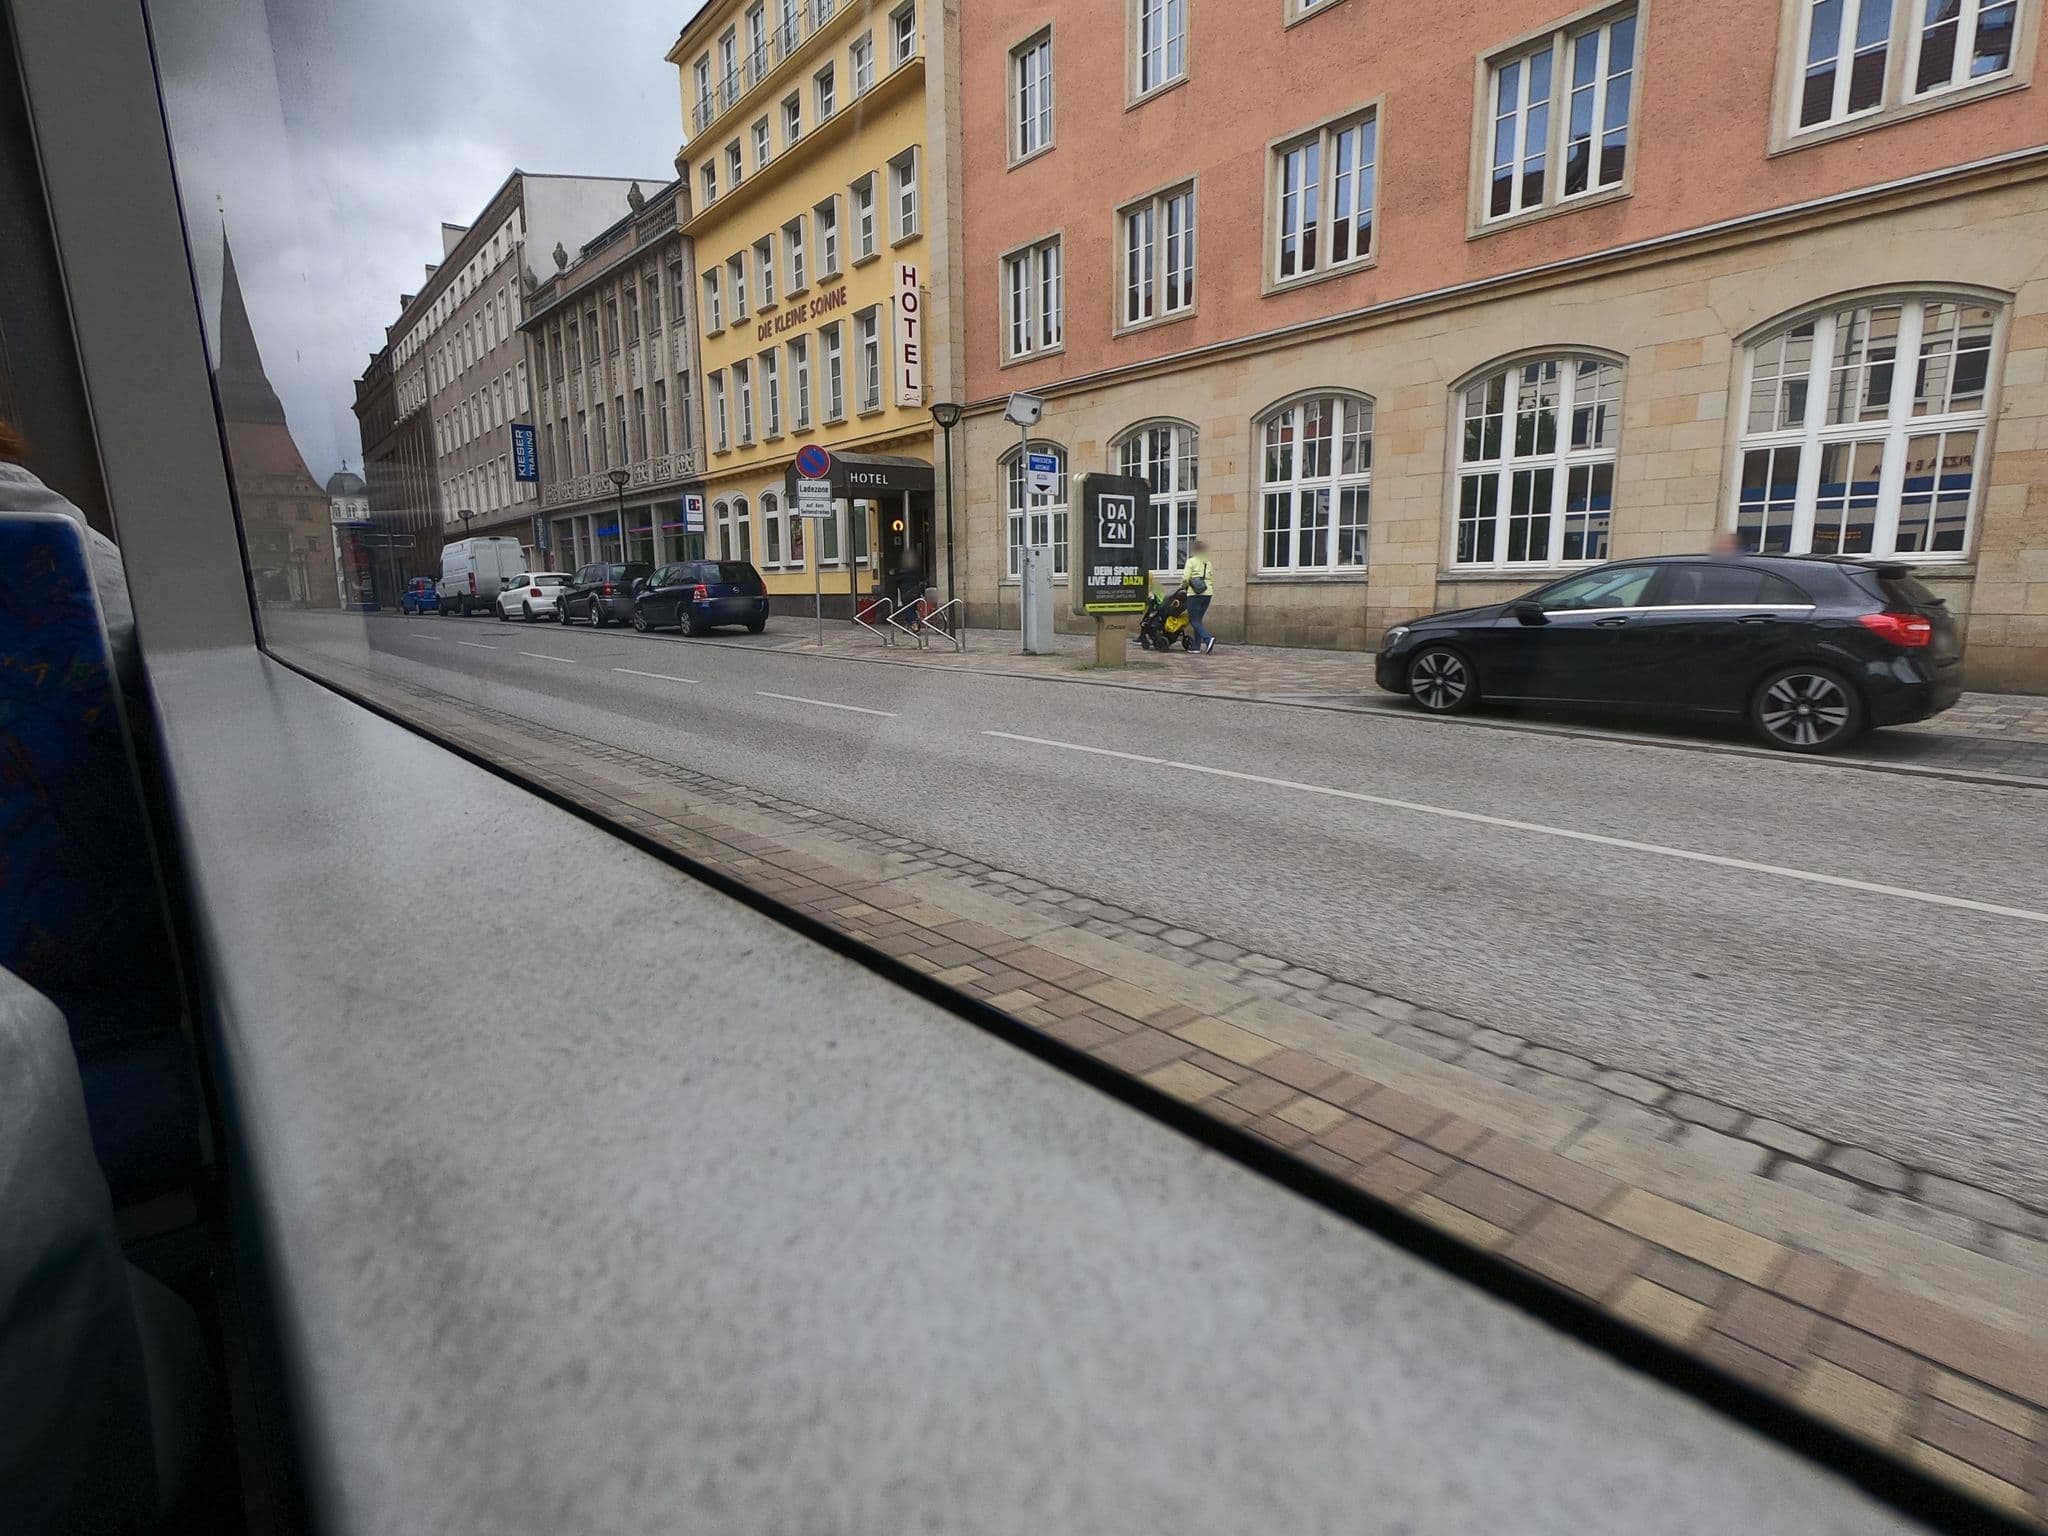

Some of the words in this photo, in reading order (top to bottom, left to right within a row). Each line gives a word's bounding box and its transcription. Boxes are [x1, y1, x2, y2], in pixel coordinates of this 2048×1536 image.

[757, 319, 773, 342] DIE
[774, 303, 808, 335] KLEINE
[809, 285, 848, 320] SONNE
[902, 265, 918, 390] HOTEL
[515, 429, 527, 477] KIESER
[526, 430, 536, 477] TRAINING
[799, 484, 829, 494] Ladezone
[849, 471, 889, 485] HOTEL
[1087, 575, 1106, 586] LIVE
[1106, 575, 1122, 586] AUF
[1122, 575, 1144, 586] DAZN
[1093, 565, 1113, 576] DEIN
[1113, 565, 1139, 576] SPORT
